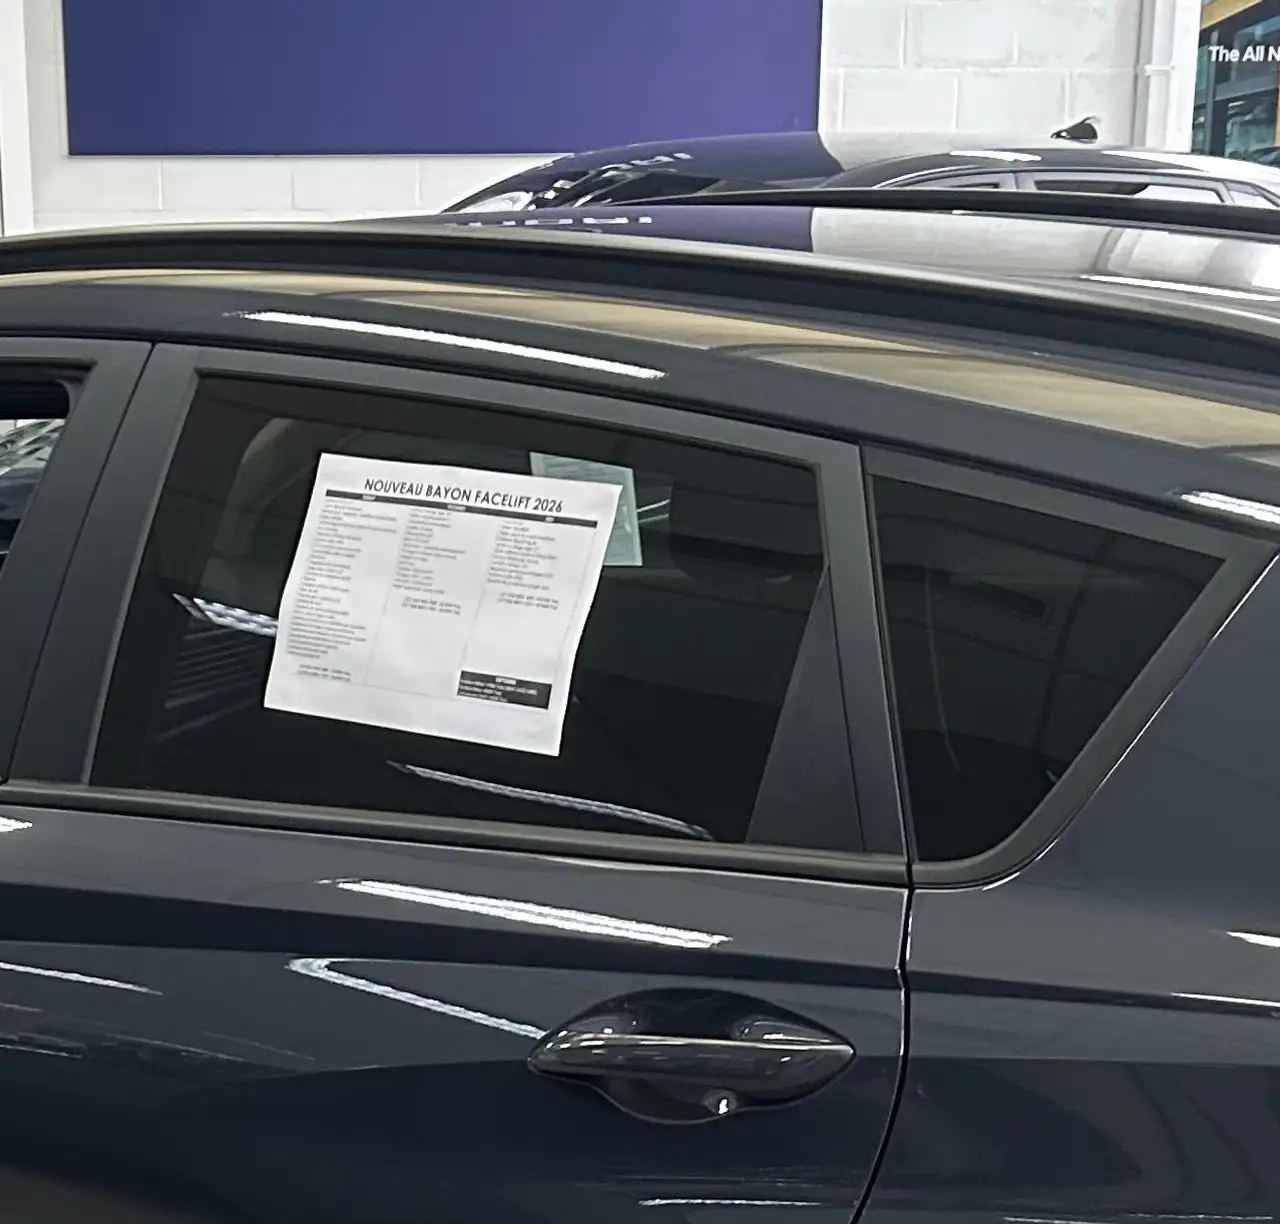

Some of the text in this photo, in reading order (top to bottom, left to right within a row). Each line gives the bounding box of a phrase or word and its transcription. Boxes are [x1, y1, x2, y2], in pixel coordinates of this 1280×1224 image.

[1208, 45, 1240, 62] The
[1242, 45, 1265, 62] All
[364, 477, 424, 496] NOUVEAU
[425, 484, 472, 504] BAYON
[474, 490, 531, 510] FACELIFT
[532, 497, 564, 514] 2026
